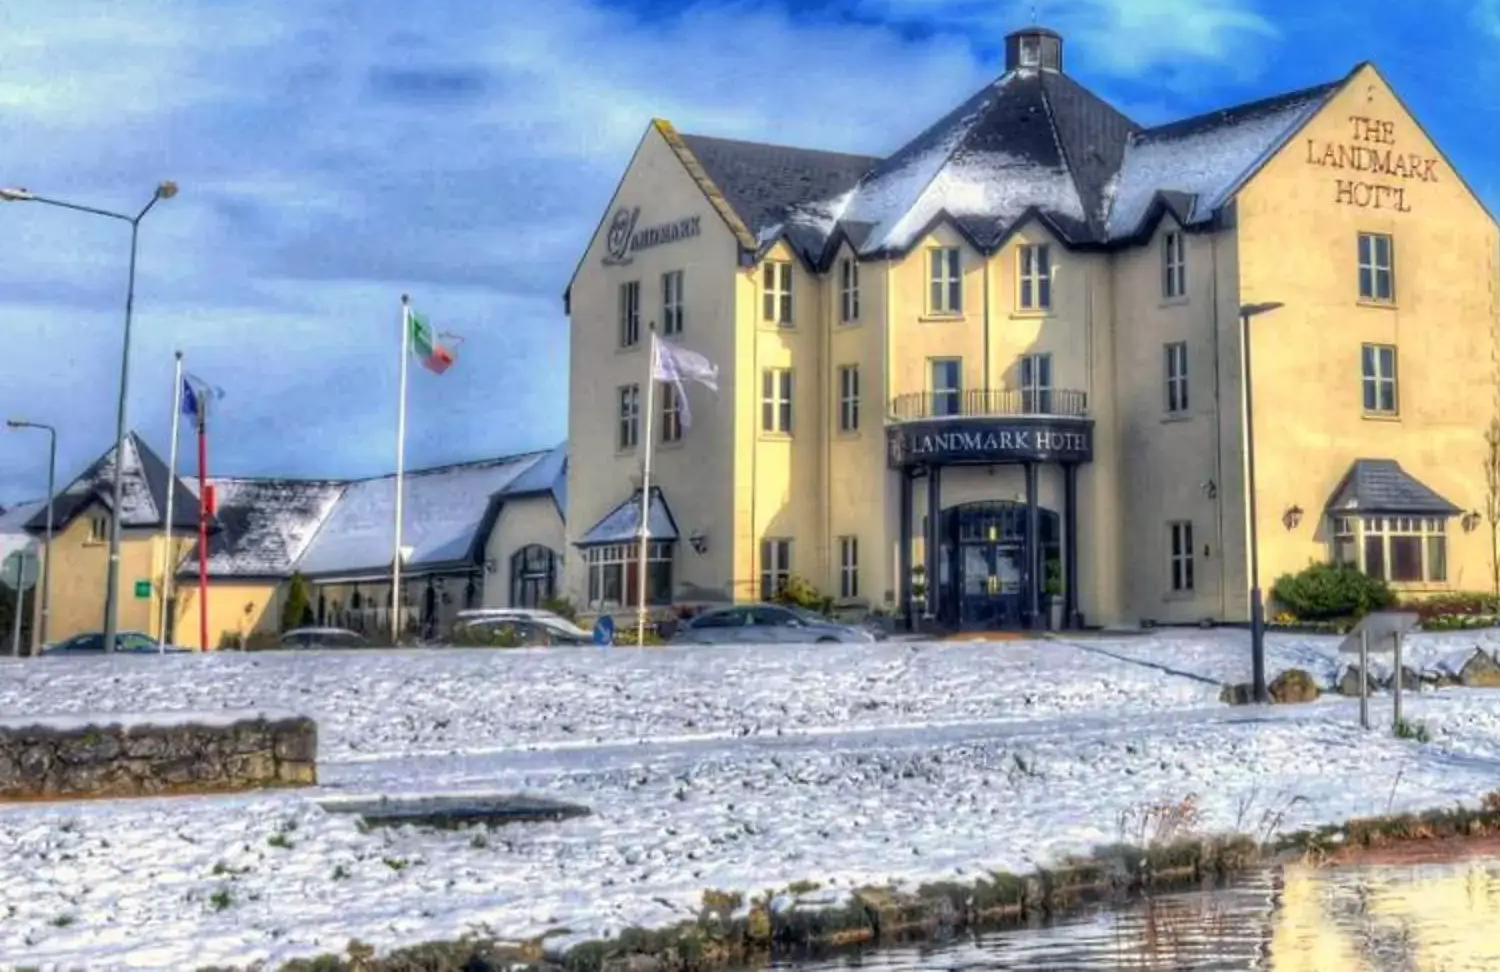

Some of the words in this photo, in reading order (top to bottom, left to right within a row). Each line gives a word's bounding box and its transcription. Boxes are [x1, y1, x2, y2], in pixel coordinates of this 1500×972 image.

[1348, 115, 1395, 145] THE
[1305, 139, 1439, 182] LANDMARK
[1334, 179, 1412, 213] HOTL
[912, 431, 1029, 453] LANDMARK
[1036, 431, 1090, 451] HOTEL
